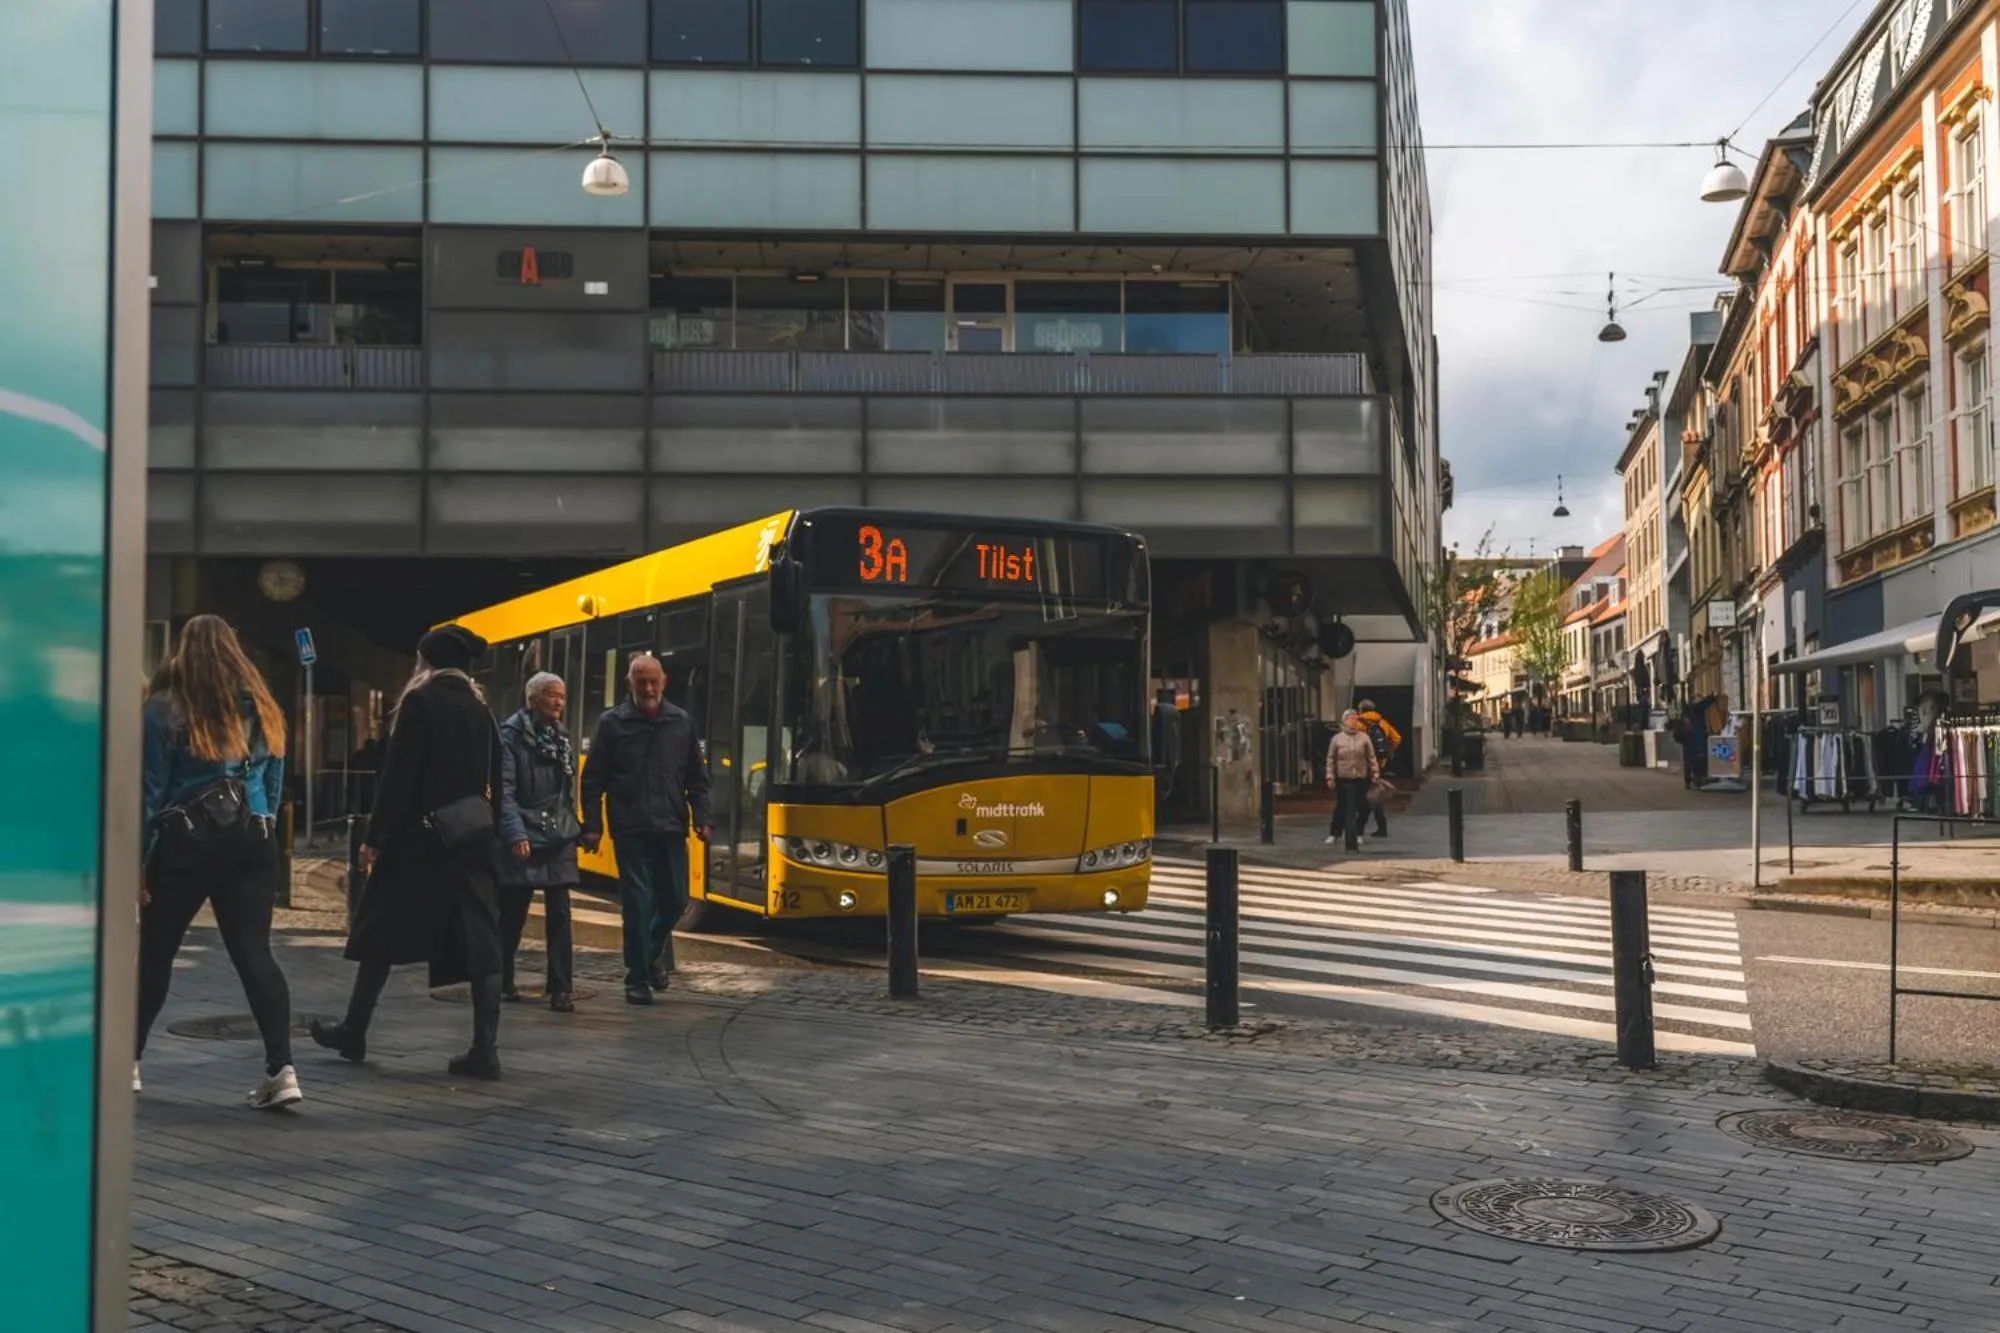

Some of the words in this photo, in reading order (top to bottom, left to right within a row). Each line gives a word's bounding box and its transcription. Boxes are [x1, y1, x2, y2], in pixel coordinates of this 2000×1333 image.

[859, 525, 907, 583] 3A
[976, 544, 1034, 581] Tilst
[976, 803, 1045, 818] midttrafik
[957, 862, 1014, 874] SOLARIS
[976, 895, 990, 909] 21
[995, 894, 1019, 909] 472
